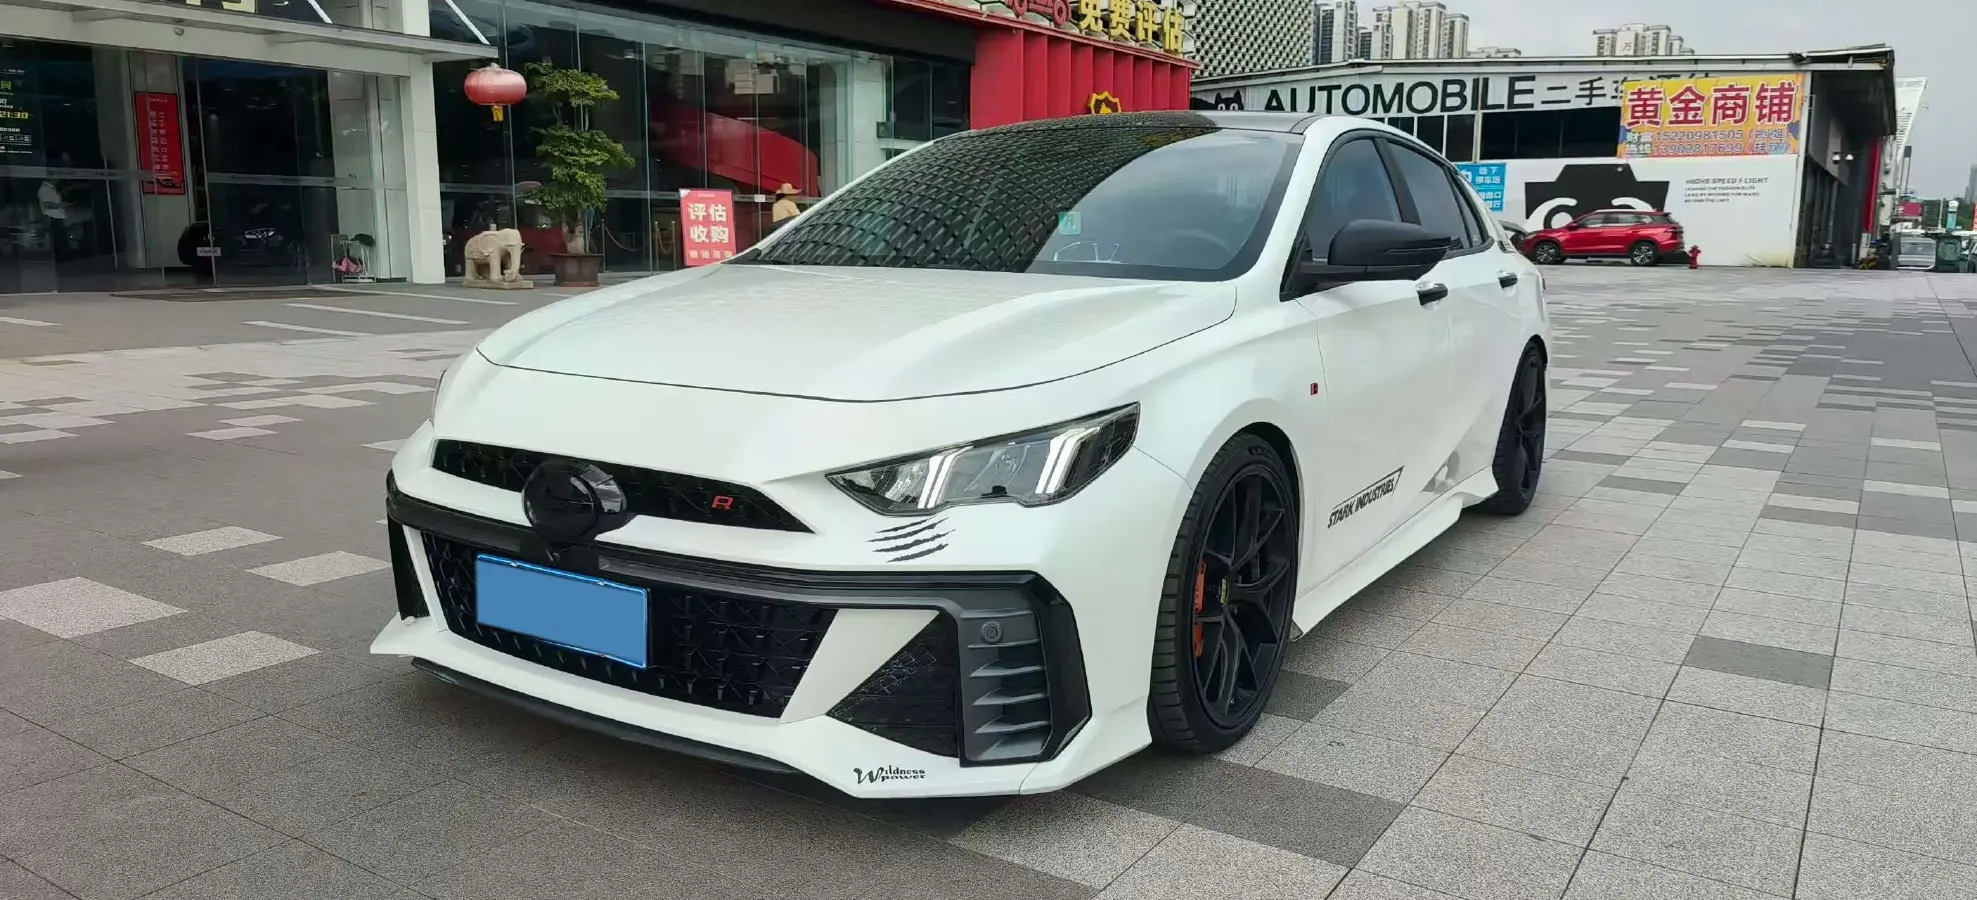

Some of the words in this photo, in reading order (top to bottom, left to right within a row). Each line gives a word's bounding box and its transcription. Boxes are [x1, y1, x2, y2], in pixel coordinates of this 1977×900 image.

[1264, 75, 1536, 116] AUTOMOBILE
[1626, 80, 1797, 128] 黄金商铺
[687, 203, 728, 222] 评估
[689, 224, 730, 244] 收购
[1327, 501, 1355, 529] STARK
[1354, 477, 1395, 512] INDUSTRIES
[853, 764, 926, 784] Wildness
